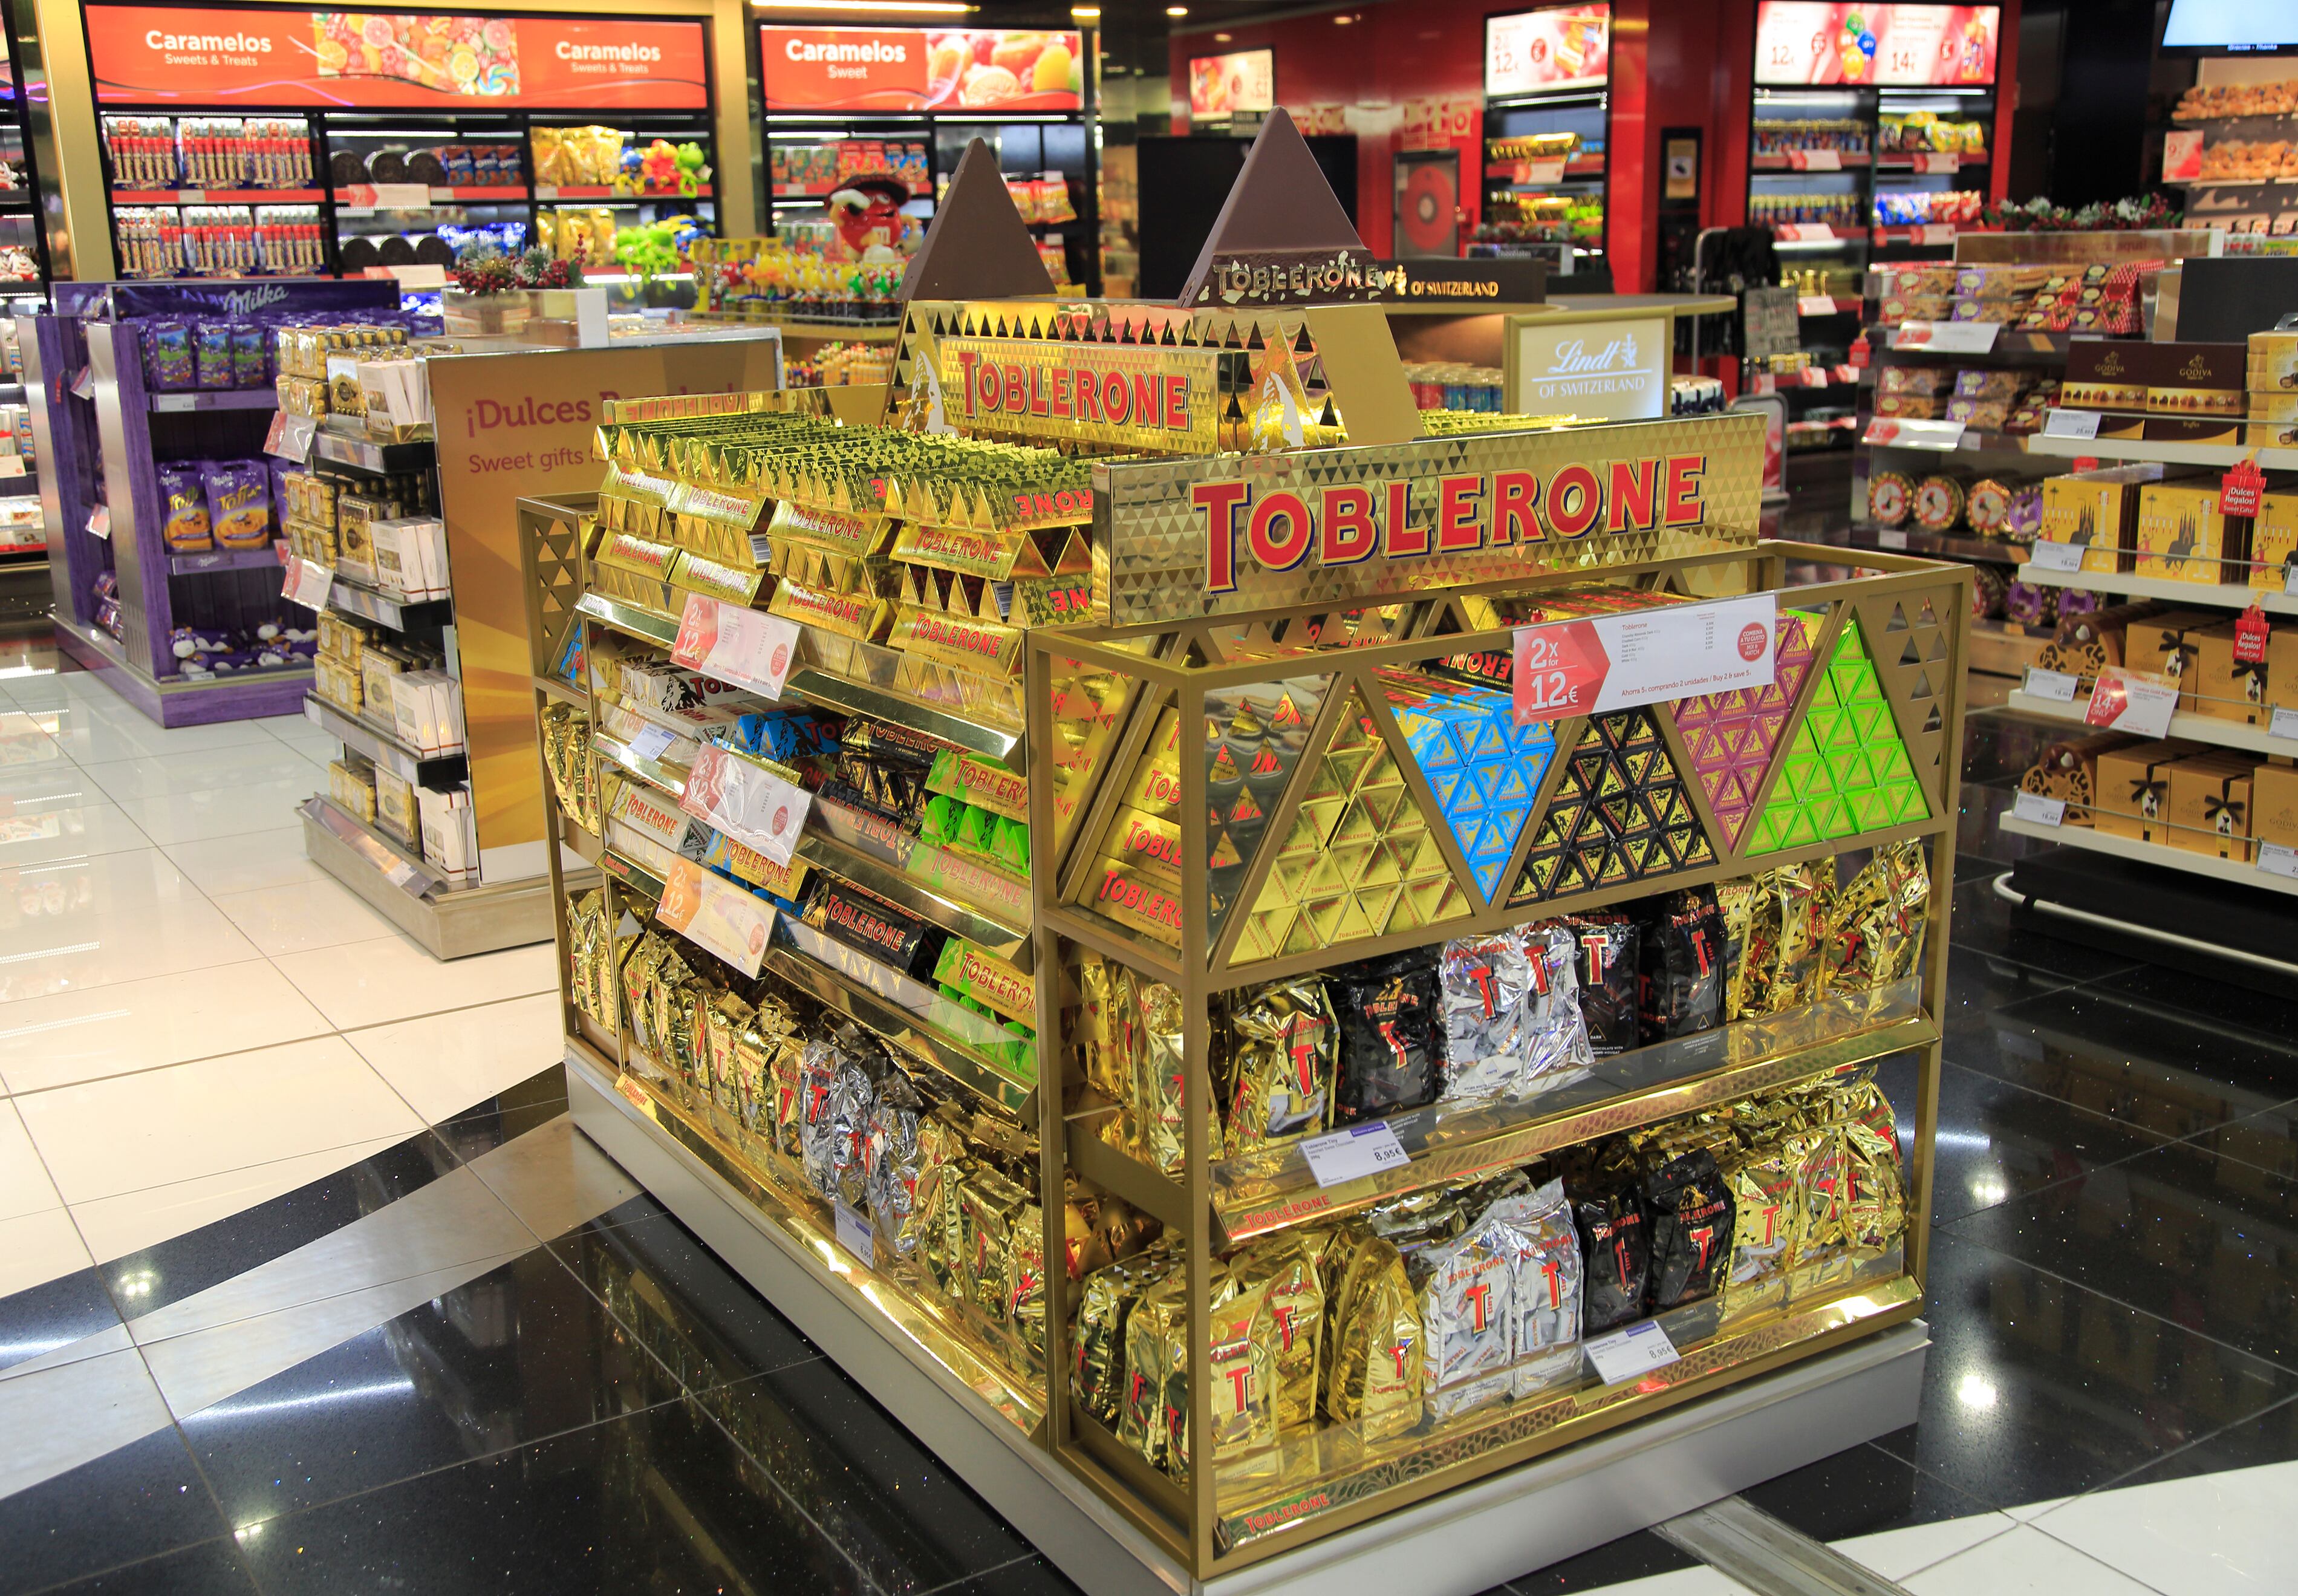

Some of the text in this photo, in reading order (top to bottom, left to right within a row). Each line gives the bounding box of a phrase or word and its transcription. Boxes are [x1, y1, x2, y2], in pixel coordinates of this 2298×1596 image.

[146, 31, 272, 52] Caramelos
[556, 42, 660, 61] Caramelos
[786, 39, 905, 63] Caramelos
[165, 54, 258, 67] Sweets & Treats
[571, 63, 648, 74] Sweets & Treats
[828, 64, 867, 79] Sweet
[1214, 264, 1380, 295] TOBLERONE
[1411, 281, 1499, 297] OF SWITZERLAND
[223, 283, 290, 314] Milka
[1548, 339, 1620, 374] Lindt
[2095, 365, 2124, 373] GODIVA
[959, 352, 1192, 432] TOBLERONE
[1540, 377, 1645, 399] OF SWITZERLAND
[466, 397, 591, 437] ¡Dulces
[469, 454, 532, 473] Sweet
[541, 449, 584, 472] gifts
[688, 483, 752, 516] TOBLERONE
[2225, 496, 2255, 506] Regalos!
[2228, 487, 2254, 496] ¡Dulces
[787, 505, 864, 541] TOBLERONE
[1189, 452, 1707, 595] TOBLERONE
[611, 536, 665, 568] TOBLERONE
[914, 526, 1005, 564] TOBLERONE
[687, 561, 750, 593] TOBLERONE
[787, 584, 864, 624] TOBLERONE
[680, 630, 701, 660] 12€
[911, 613, 1003, 658] TOBLERONE
[2238, 640, 2261, 650] Regalos!
[2240, 633, 2261, 642] ¡Dulces
[1548, 658, 1559, 667] for
[1531, 671, 1578, 711] 12€
[1649, 682, 1679, 693] comprando
[1685, 677, 1708, 686] unidades
[1722, 707, 1748, 716] TOBLERONE
[2091, 708, 2109, 717] ONLY
[1453, 724, 1470, 754] TOBLERONE
[1523, 737, 1551, 746] TOBLERONE
[1626, 737, 1655, 747] TOBLERONE
[1428, 758, 1457, 768] TOBLERONE
[1700, 755, 1726, 764] TOBLERONE
[1649, 774, 1676, 783] TOBLERONE
[1499, 793, 1528, 801] TOBLERONE
[1552, 792, 1581, 802] TOBLERONE
[627, 794, 679, 837] TOBLERONE
[1454, 804, 1483, 813] TOBLERONE
[1391, 819, 1422, 830] TOBLERONE
[1339, 832, 1372, 842] TOBLERONE
[1577, 832, 1605, 843] TOBLERONE
[1476, 847, 1506, 856] TOBLERONE
[1531, 843, 1560, 853] TOBLERONE
[724, 836, 793, 885] TOBLERONE
[1414, 864, 1445, 875] TOBLERONE
[1644, 864, 1671, 875] TOBLERONE
[1685, 855, 1712, 866] TOBLERONE
[931, 846, 1025, 906] TOBLERONE
[1600, 873, 1627, 884] TOBLERONE
[1311, 884, 1343, 894] TOBLERONE
[1508, 893, 1539, 904] TOBLERONE
[1555, 883, 1584, 894] TOBLERONE
[665, 891, 685, 923] 12€
[825, 894, 906, 952] TOBLERONE
[1338, 928, 1370, 939] TOBLERONE
[1581, 934, 1609, 985] T
[1691, 930, 1711, 980] T
[1525, 945, 1550, 997] T
[1470, 967, 1496, 1020] T
[1291, 1044, 1318, 1098] T
[807, 1084, 830, 1127] T
[1305, 1140, 1327, 1150] Toblerone
[1375, 1147, 1402, 1161] 8,95€
[1245, 1194, 1332, 1228] TOBLERONE
[1761, 1205, 1782, 1248] T
[1690, 1226, 1714, 1272] T
[1447, 1256, 1505, 1287] TOBLERONE
[1541, 1260, 1561, 1311] T
[1465, 1283, 1490, 1335] T
[1273, 1305, 1298, 1353] T
[1649, 1345, 1673, 1359] 8,95€
[1226, 1365, 1254, 1417] T
[1245, 1493, 1329, 1534] TOBLERONE
